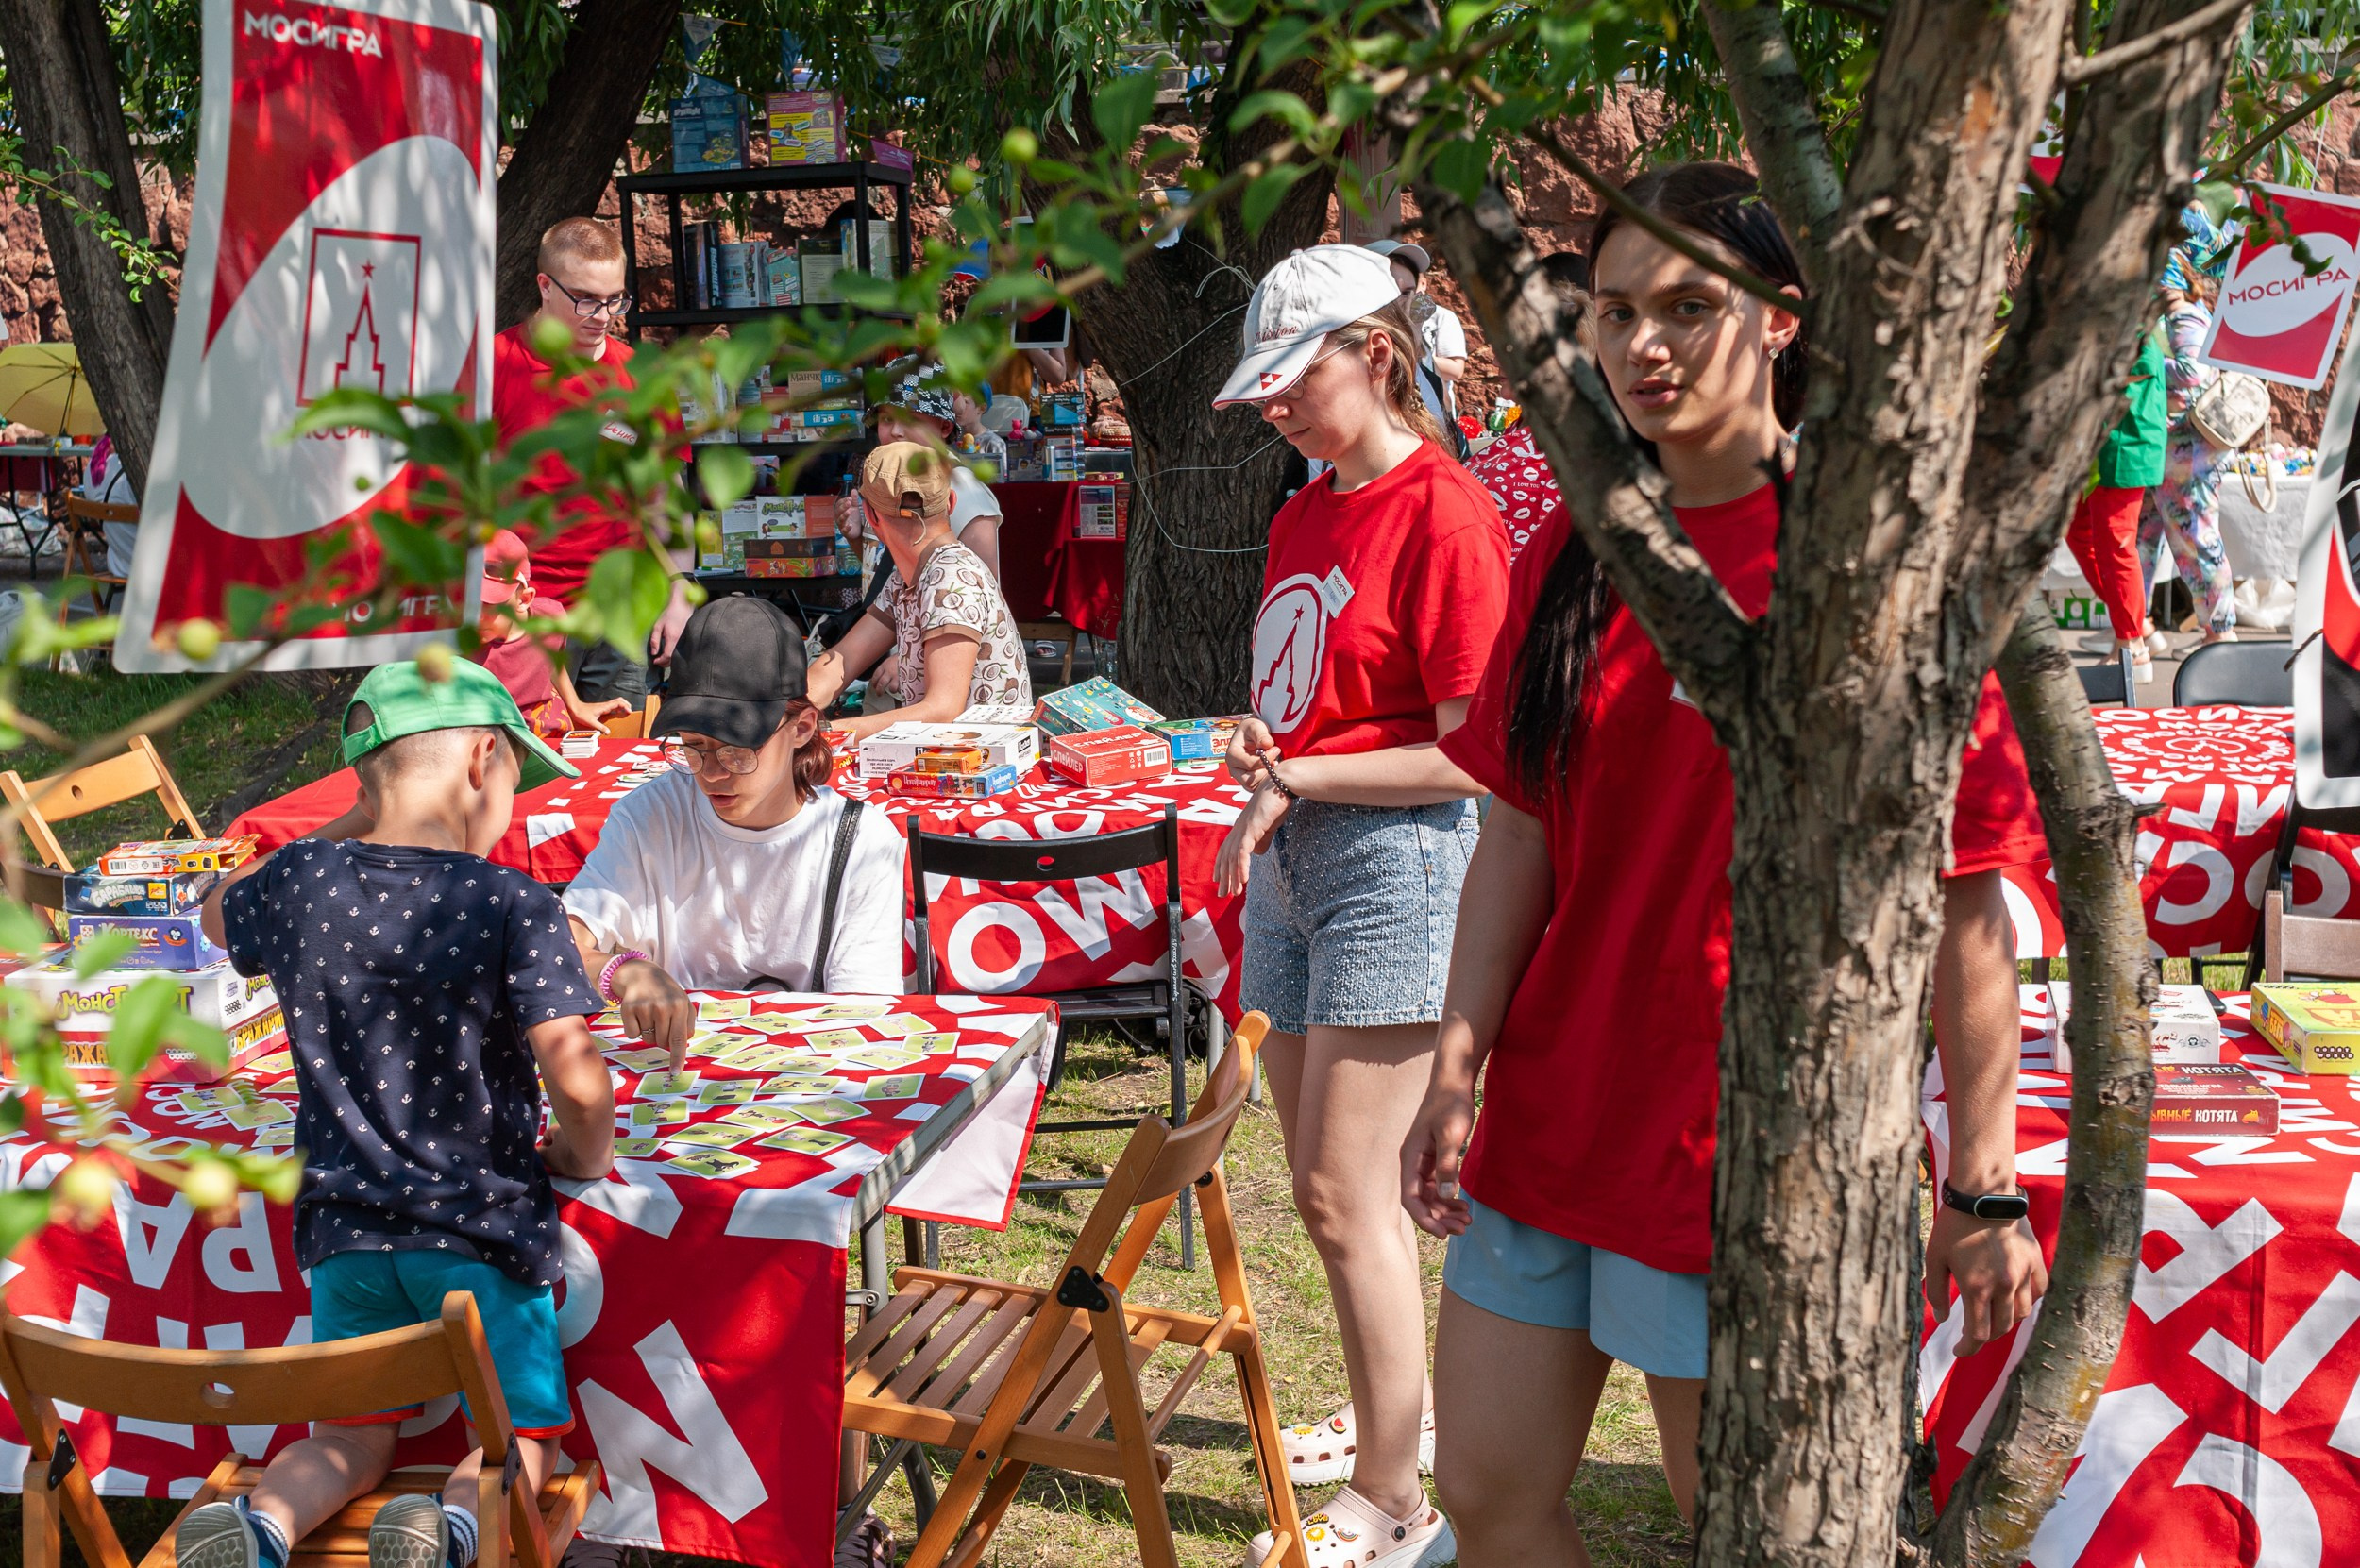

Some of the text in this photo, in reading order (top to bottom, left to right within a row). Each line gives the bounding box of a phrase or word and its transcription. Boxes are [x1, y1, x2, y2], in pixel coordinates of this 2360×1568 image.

[244, 9, 383, 59] МОСИГРА
[2181, 1066, 2245, 1074] КОТЯТА
[2150, 1107, 2238, 1122] ЫВНЫЕ КОТЯТА
